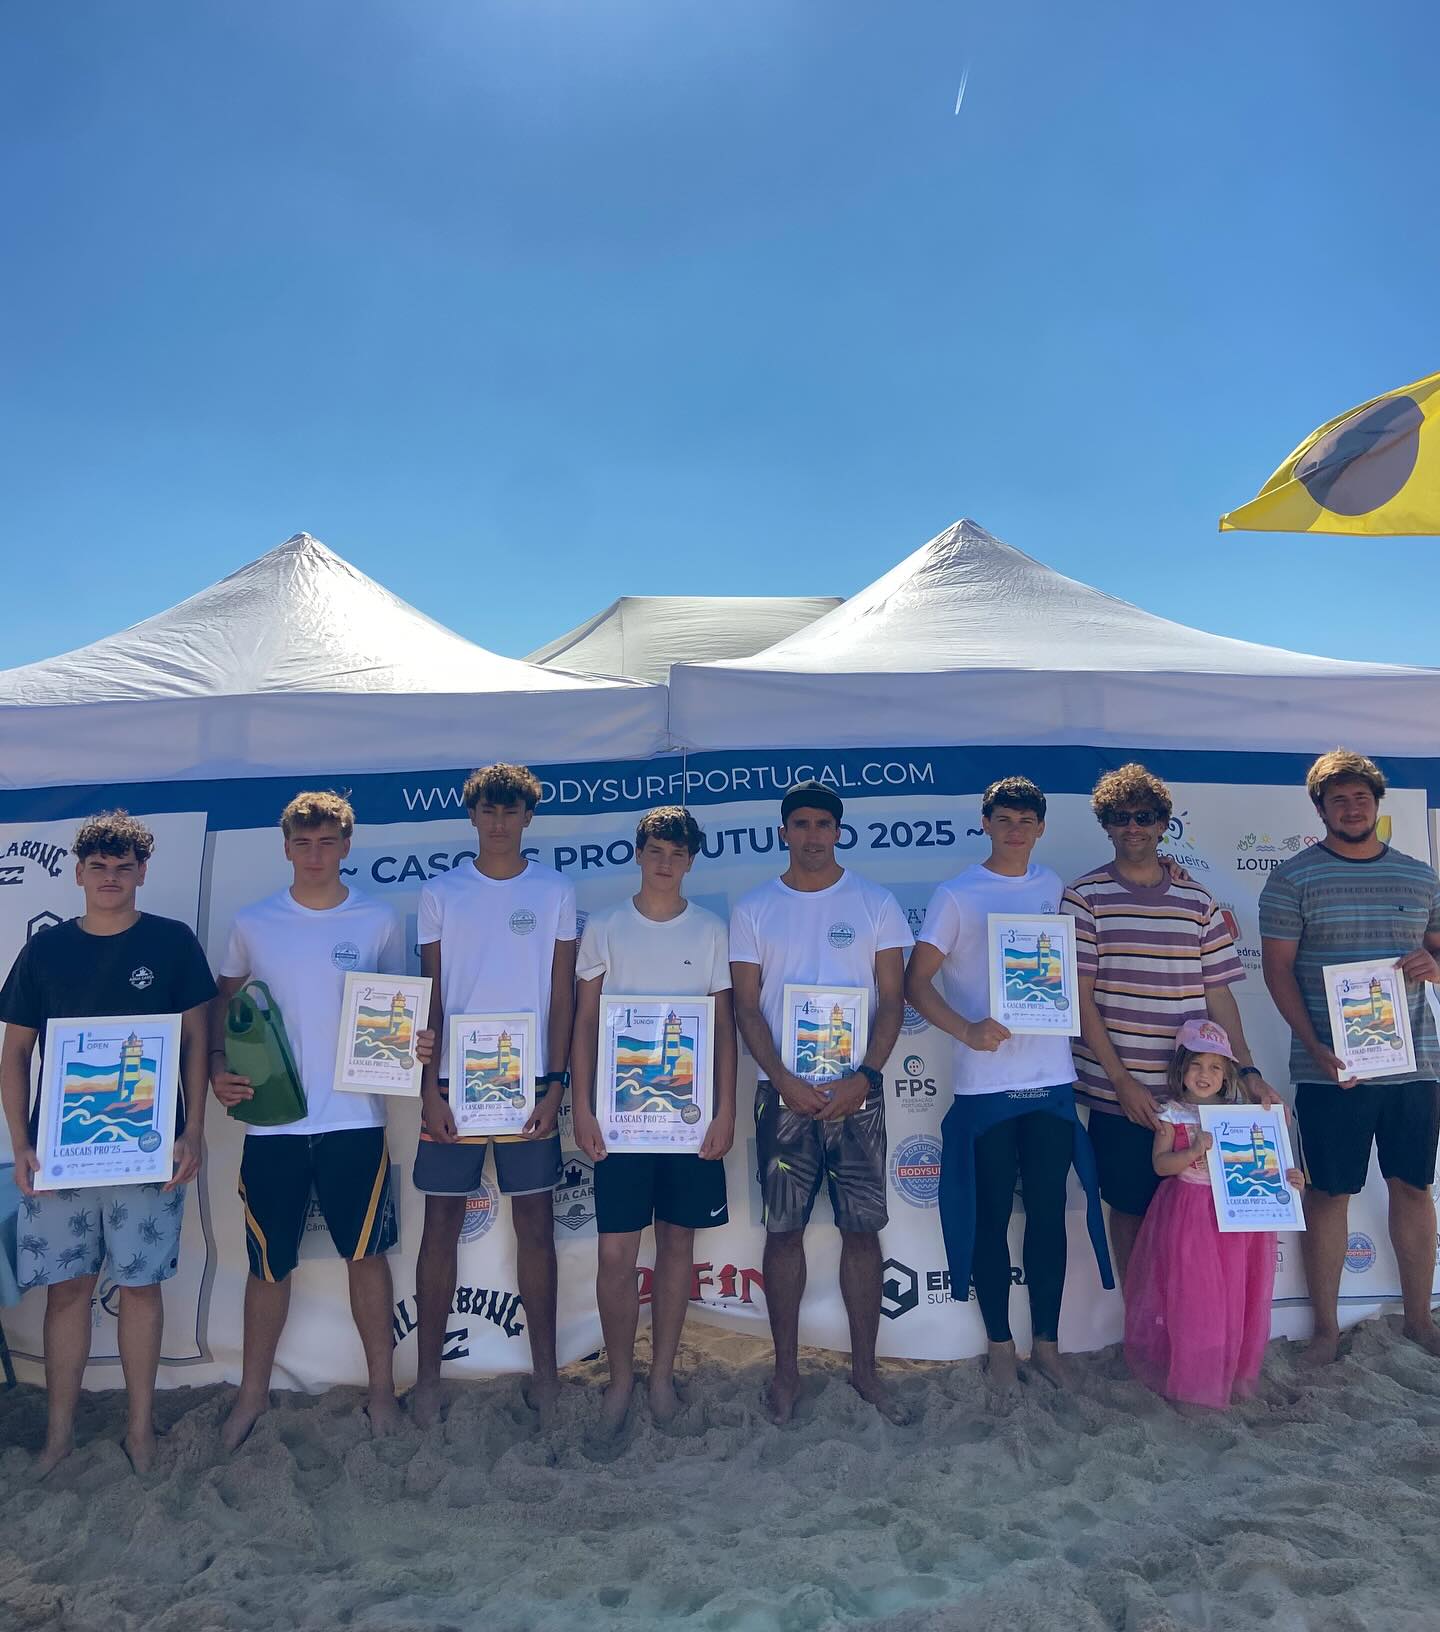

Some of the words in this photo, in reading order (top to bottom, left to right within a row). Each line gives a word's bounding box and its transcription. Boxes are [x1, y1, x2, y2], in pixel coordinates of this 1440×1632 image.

[554, 839, 634, 872] PRO
[701, 823, 859, 859] UTUO
[869, 819, 956, 849] 2025
[1237, 858, 1288, 871] LOUR
[1237, 947, 1261, 957] edras
[86, 1042, 109, 1050] OPEN
[895, 1078, 937, 1098] FPS
[615, 1113, 642, 1123] CASCAIS
[60, 1145, 92, 1157] CASCAIS
[900, 1167, 940, 1177] BODYSU
[554, 1192, 570, 1203] UA
[572, 1187, 594, 1199] CAR
